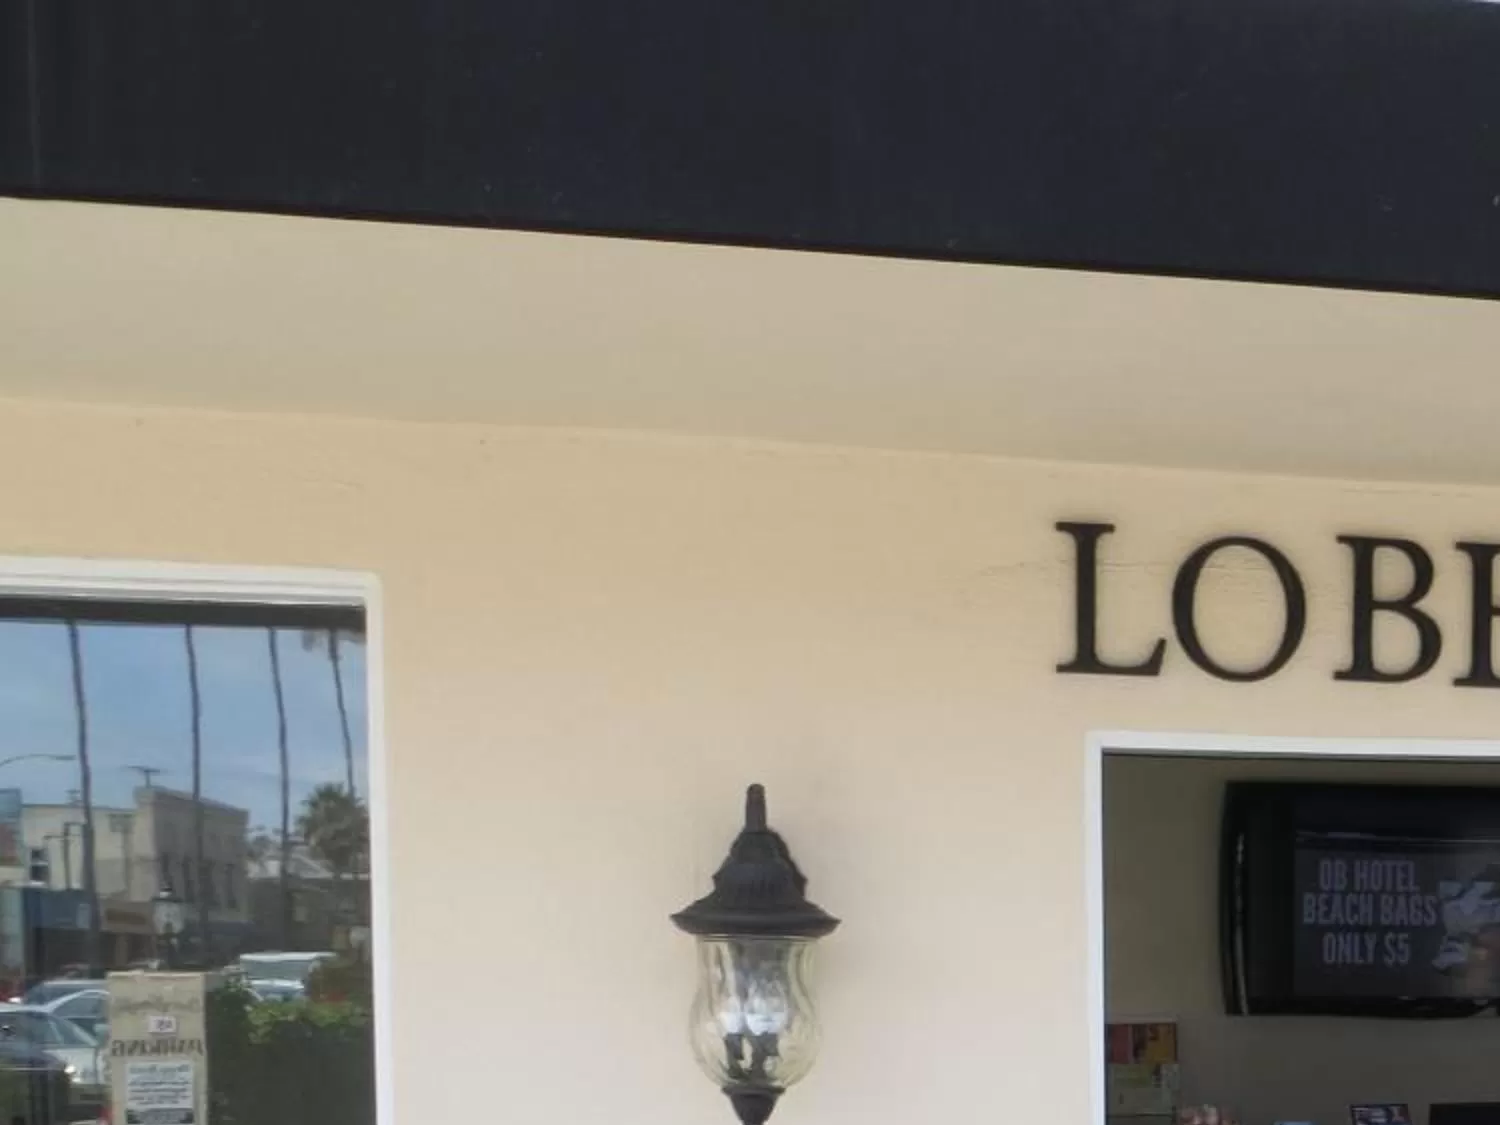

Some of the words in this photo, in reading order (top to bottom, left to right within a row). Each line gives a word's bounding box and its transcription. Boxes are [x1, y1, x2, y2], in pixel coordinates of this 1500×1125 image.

[1319, 859, 1348, 891] OB
[1354, 859, 1421, 893] HOTEL
[1302, 892, 1375, 926] BEACH
[1380, 893, 1439, 927] BAGS
[1322, 931, 1377, 966] ONLY
[1384, 932, 1411, 967] $5
